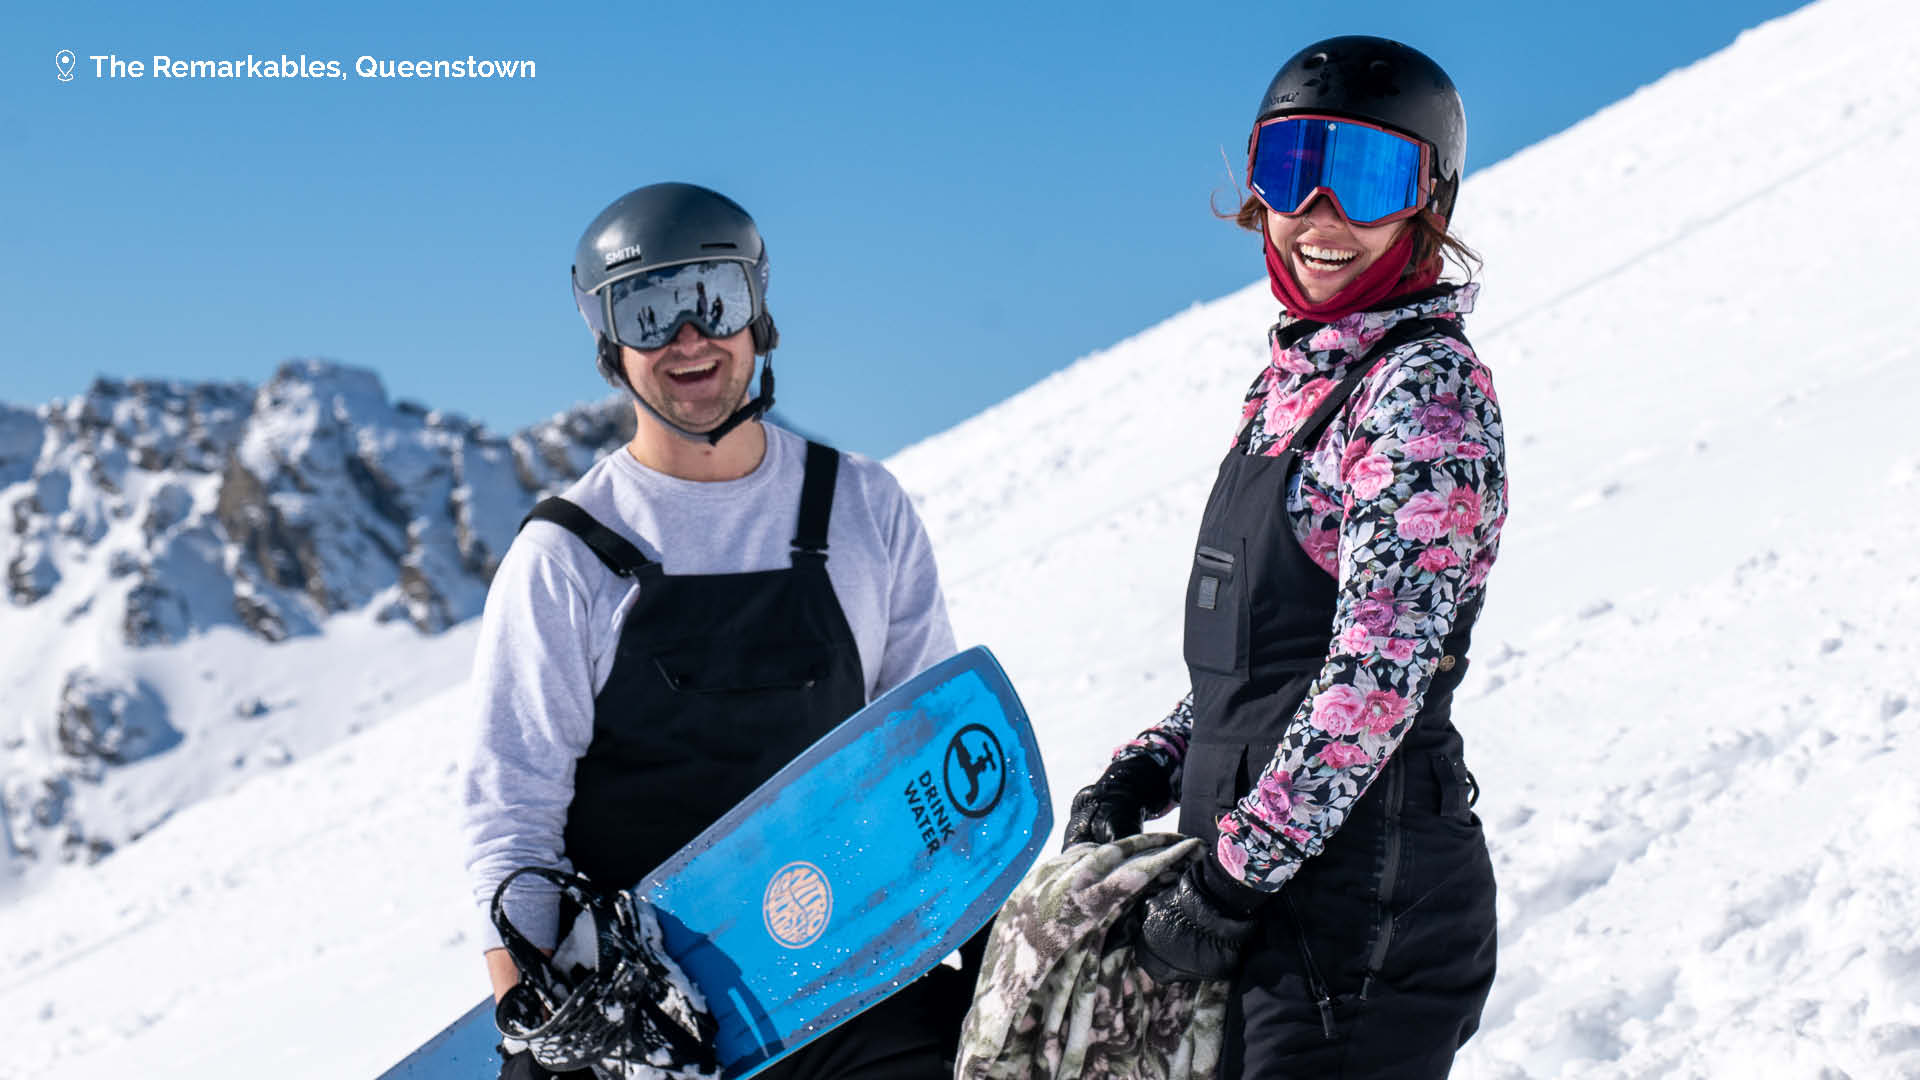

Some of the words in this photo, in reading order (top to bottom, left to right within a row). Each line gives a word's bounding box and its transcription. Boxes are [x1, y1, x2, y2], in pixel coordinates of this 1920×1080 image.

[605, 244, 640, 264] SMITH
[904, 779, 940, 856] WATER
[918, 771, 954, 842] DRINK
[791, 868, 827, 937] NITRO
